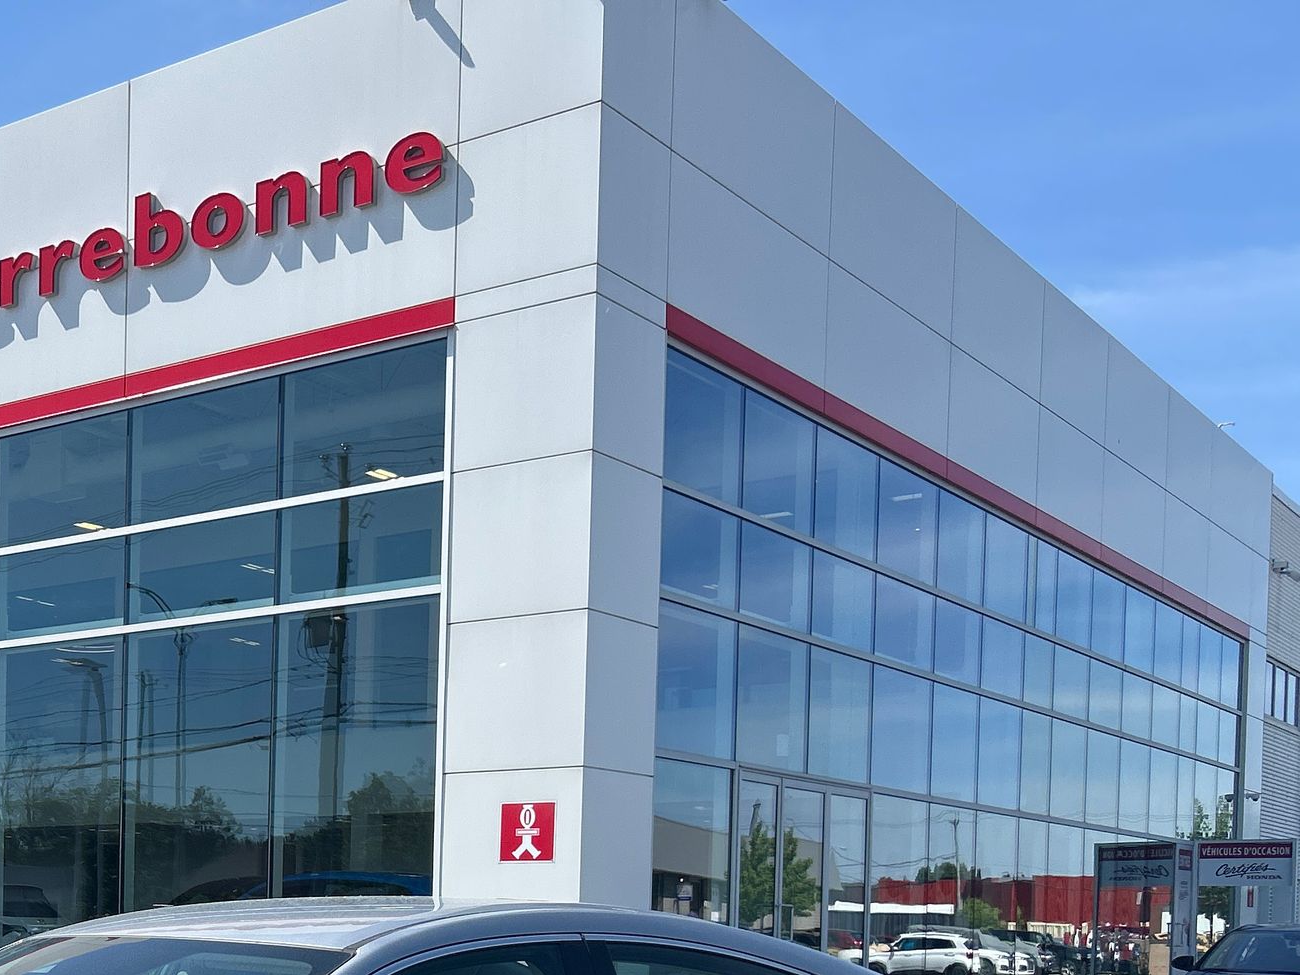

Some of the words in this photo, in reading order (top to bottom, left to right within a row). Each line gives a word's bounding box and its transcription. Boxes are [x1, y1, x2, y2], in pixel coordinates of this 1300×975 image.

[1201, 845, 1242, 856] VÉHICULES
[1244, 846, 1291, 856] D'OCCASION
[1215, 862, 1276, 878] Certifiés
